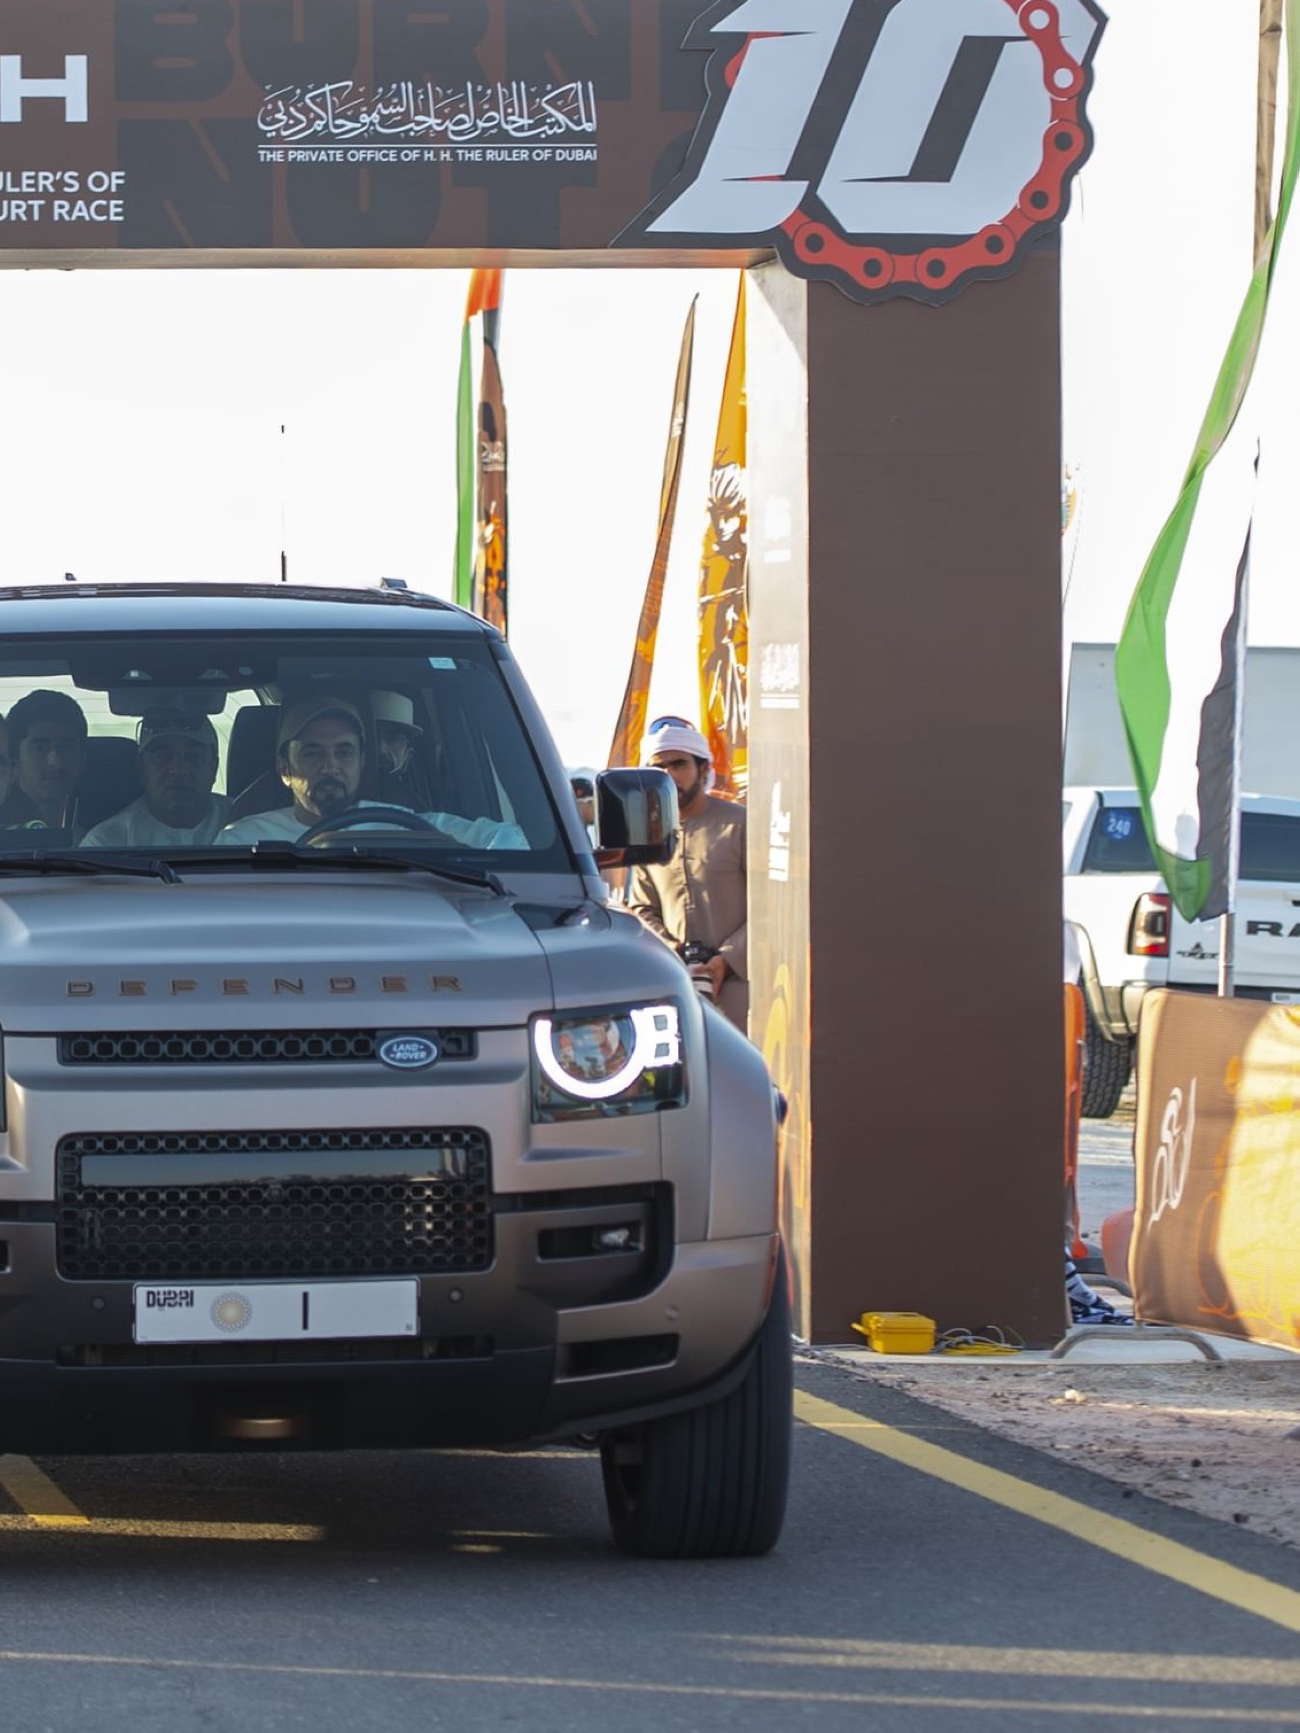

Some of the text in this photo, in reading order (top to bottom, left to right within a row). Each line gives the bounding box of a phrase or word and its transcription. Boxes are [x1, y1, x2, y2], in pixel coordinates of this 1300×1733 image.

[645, 0, 1100, 234] 10
[258, 150, 598, 162] THE PRIVATE OFFICE OF H. H. THE RULER OF DUBAI
[86, 171, 126, 193] OF
[53, 200, 125, 221] RACE
[66, 975, 463, 997] DEFENDER
[393, 1043, 418, 1052] LAND
[395, 1050, 427, 1060] ROVER
[146, 1290, 309, 1331] DUBAI 1
